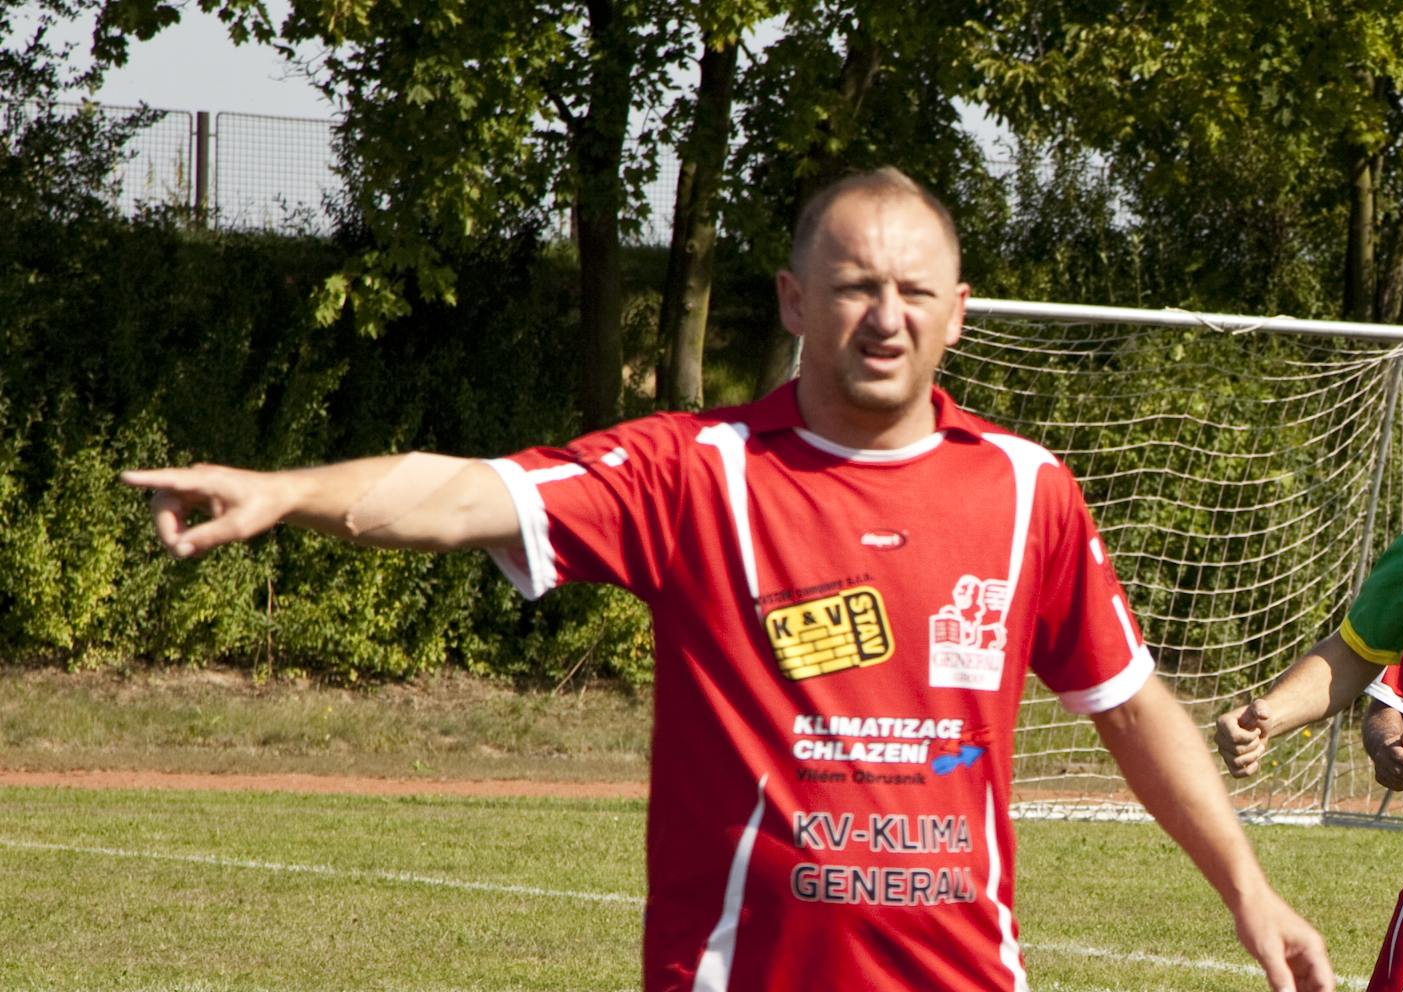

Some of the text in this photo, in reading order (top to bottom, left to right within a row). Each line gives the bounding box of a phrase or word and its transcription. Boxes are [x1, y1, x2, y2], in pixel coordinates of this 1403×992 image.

[772, 594, 886, 655] K & V STAV
[793, 714, 963, 739] KLIMATIZACE
[793, 740, 930, 764] CHLAZENÍ
[793, 811, 972, 852] KV-KLIMA
